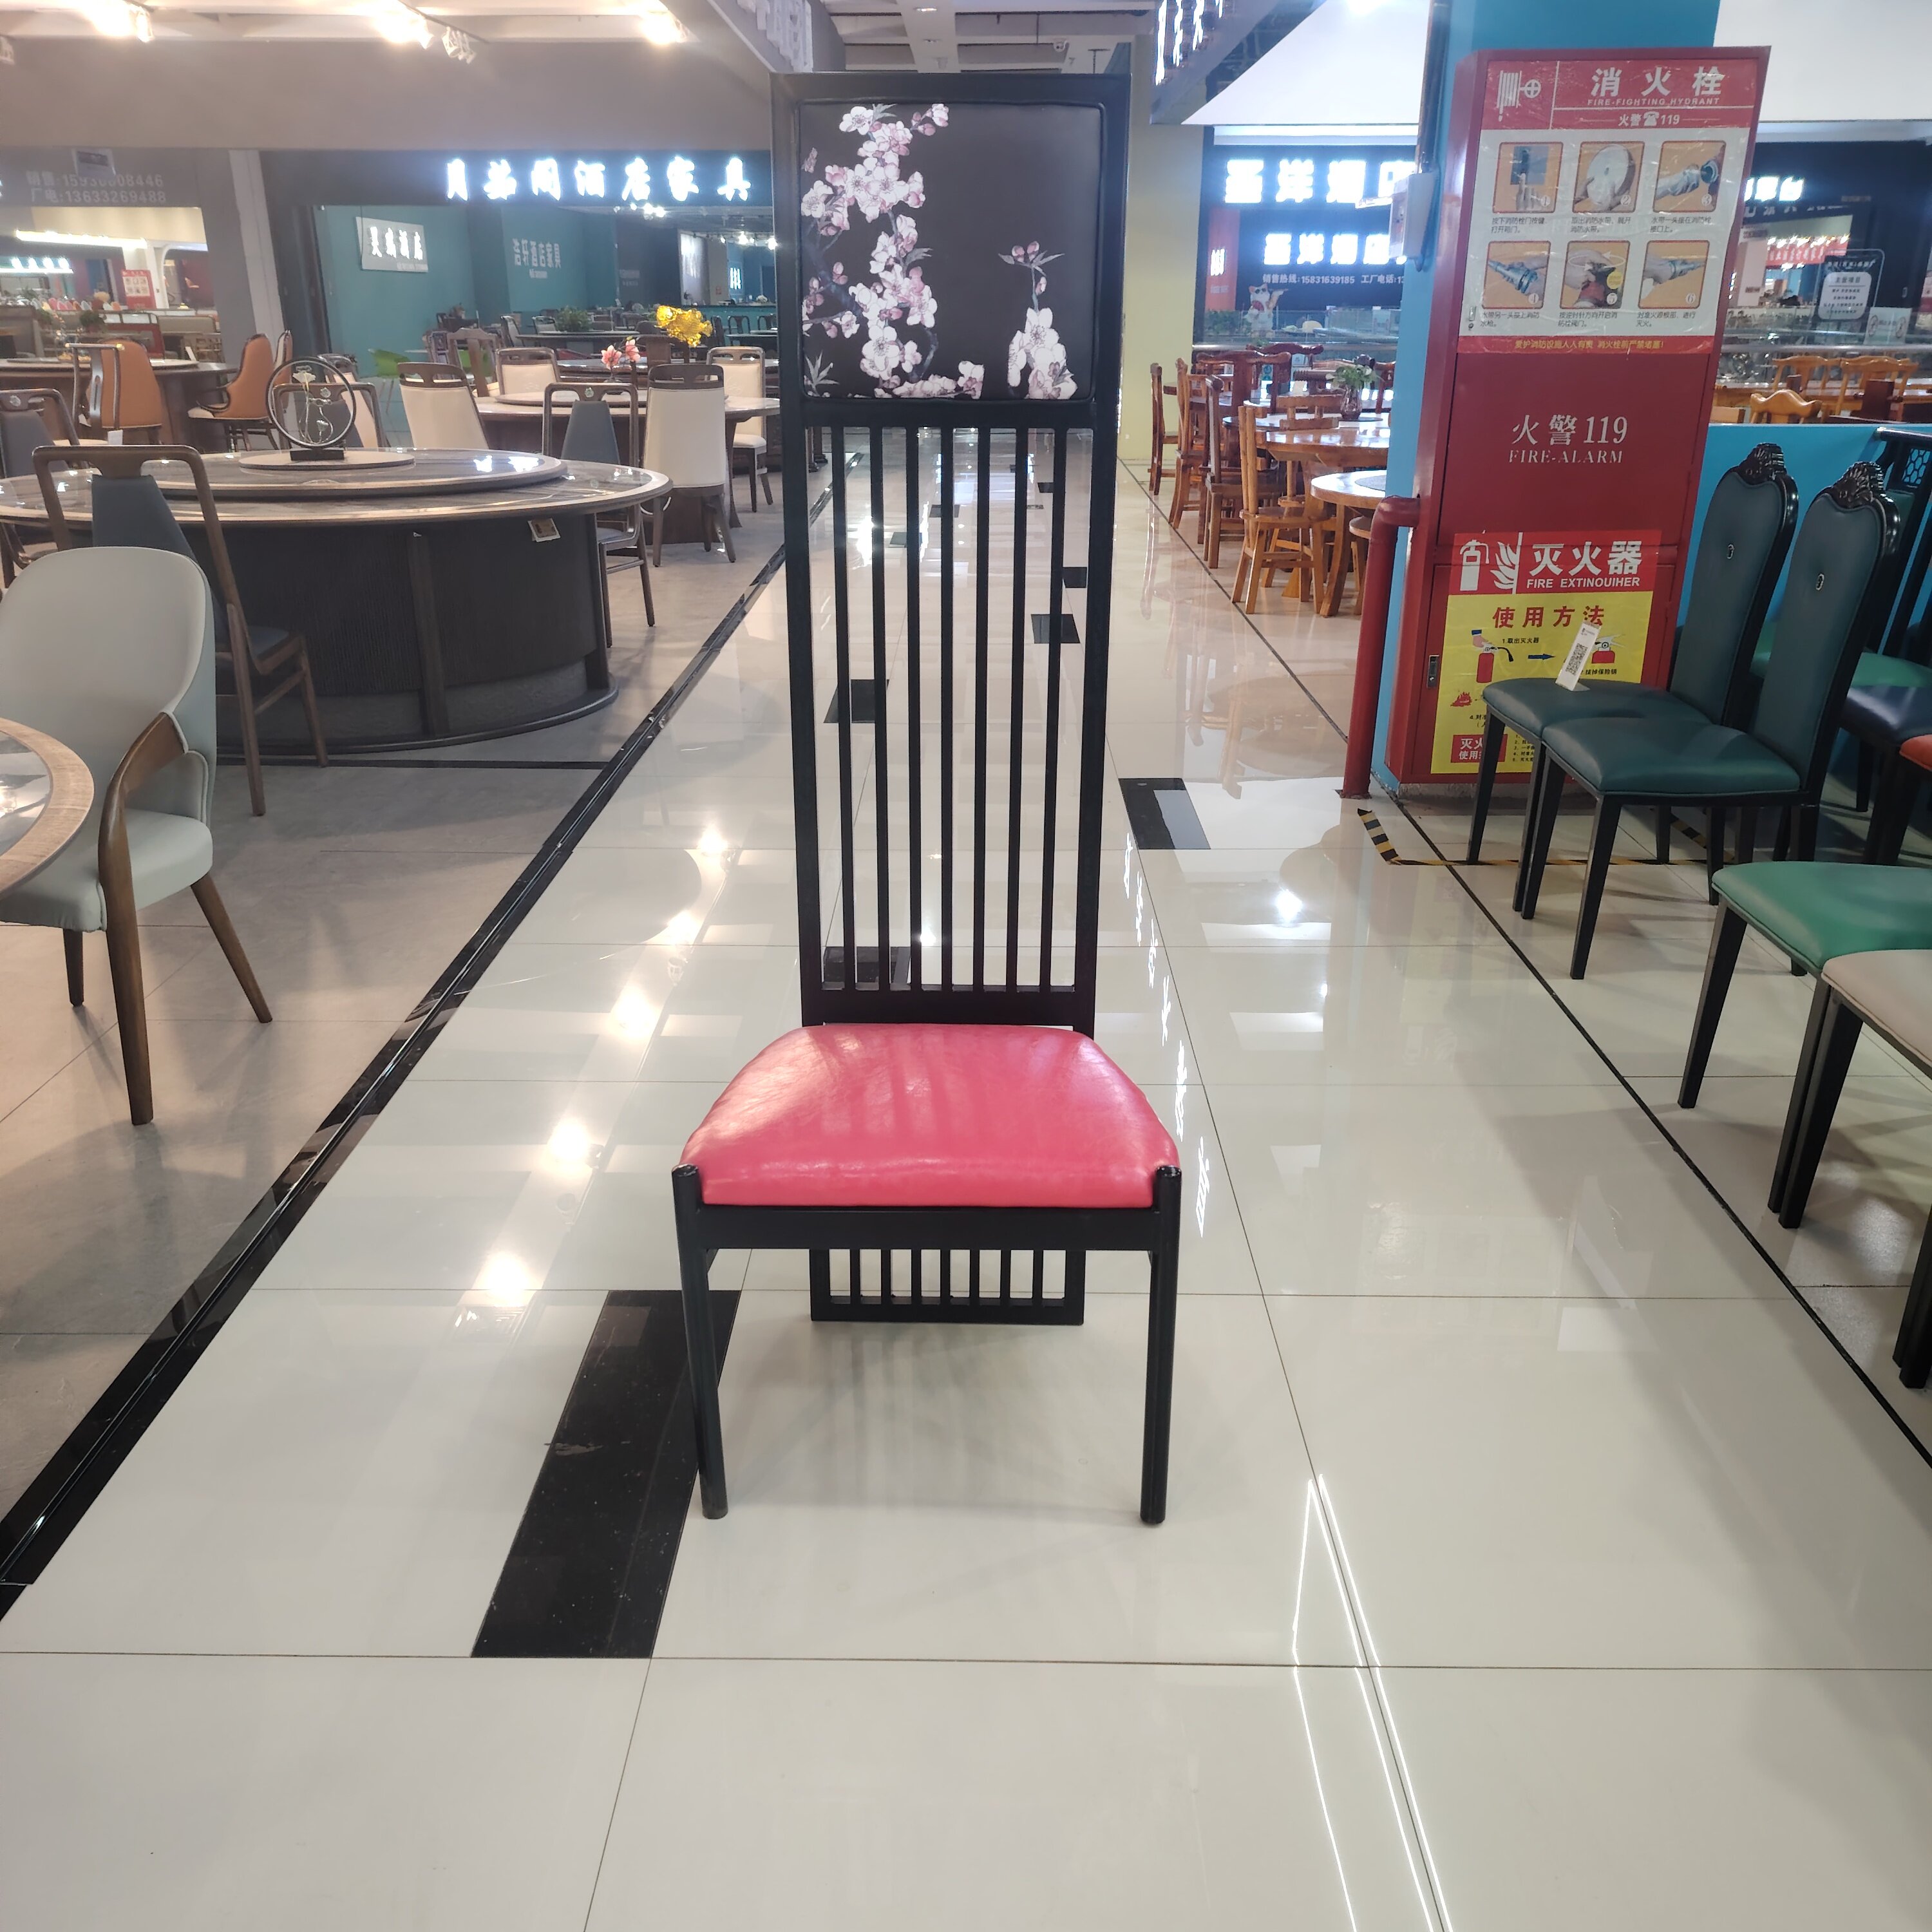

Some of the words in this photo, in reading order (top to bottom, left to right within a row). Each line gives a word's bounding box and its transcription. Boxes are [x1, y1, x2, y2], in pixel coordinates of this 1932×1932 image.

[1591, 66, 1725, 97] 消火栓
[1660, 115, 1680, 124] 119
[1509, 450, 1623, 463] FIRE-ALARM
[1530, 541, 1642, 575] 灭火器
[1526, 578, 1553, 589] FIRE
[1492, 605, 1605, 629] 使用方法
